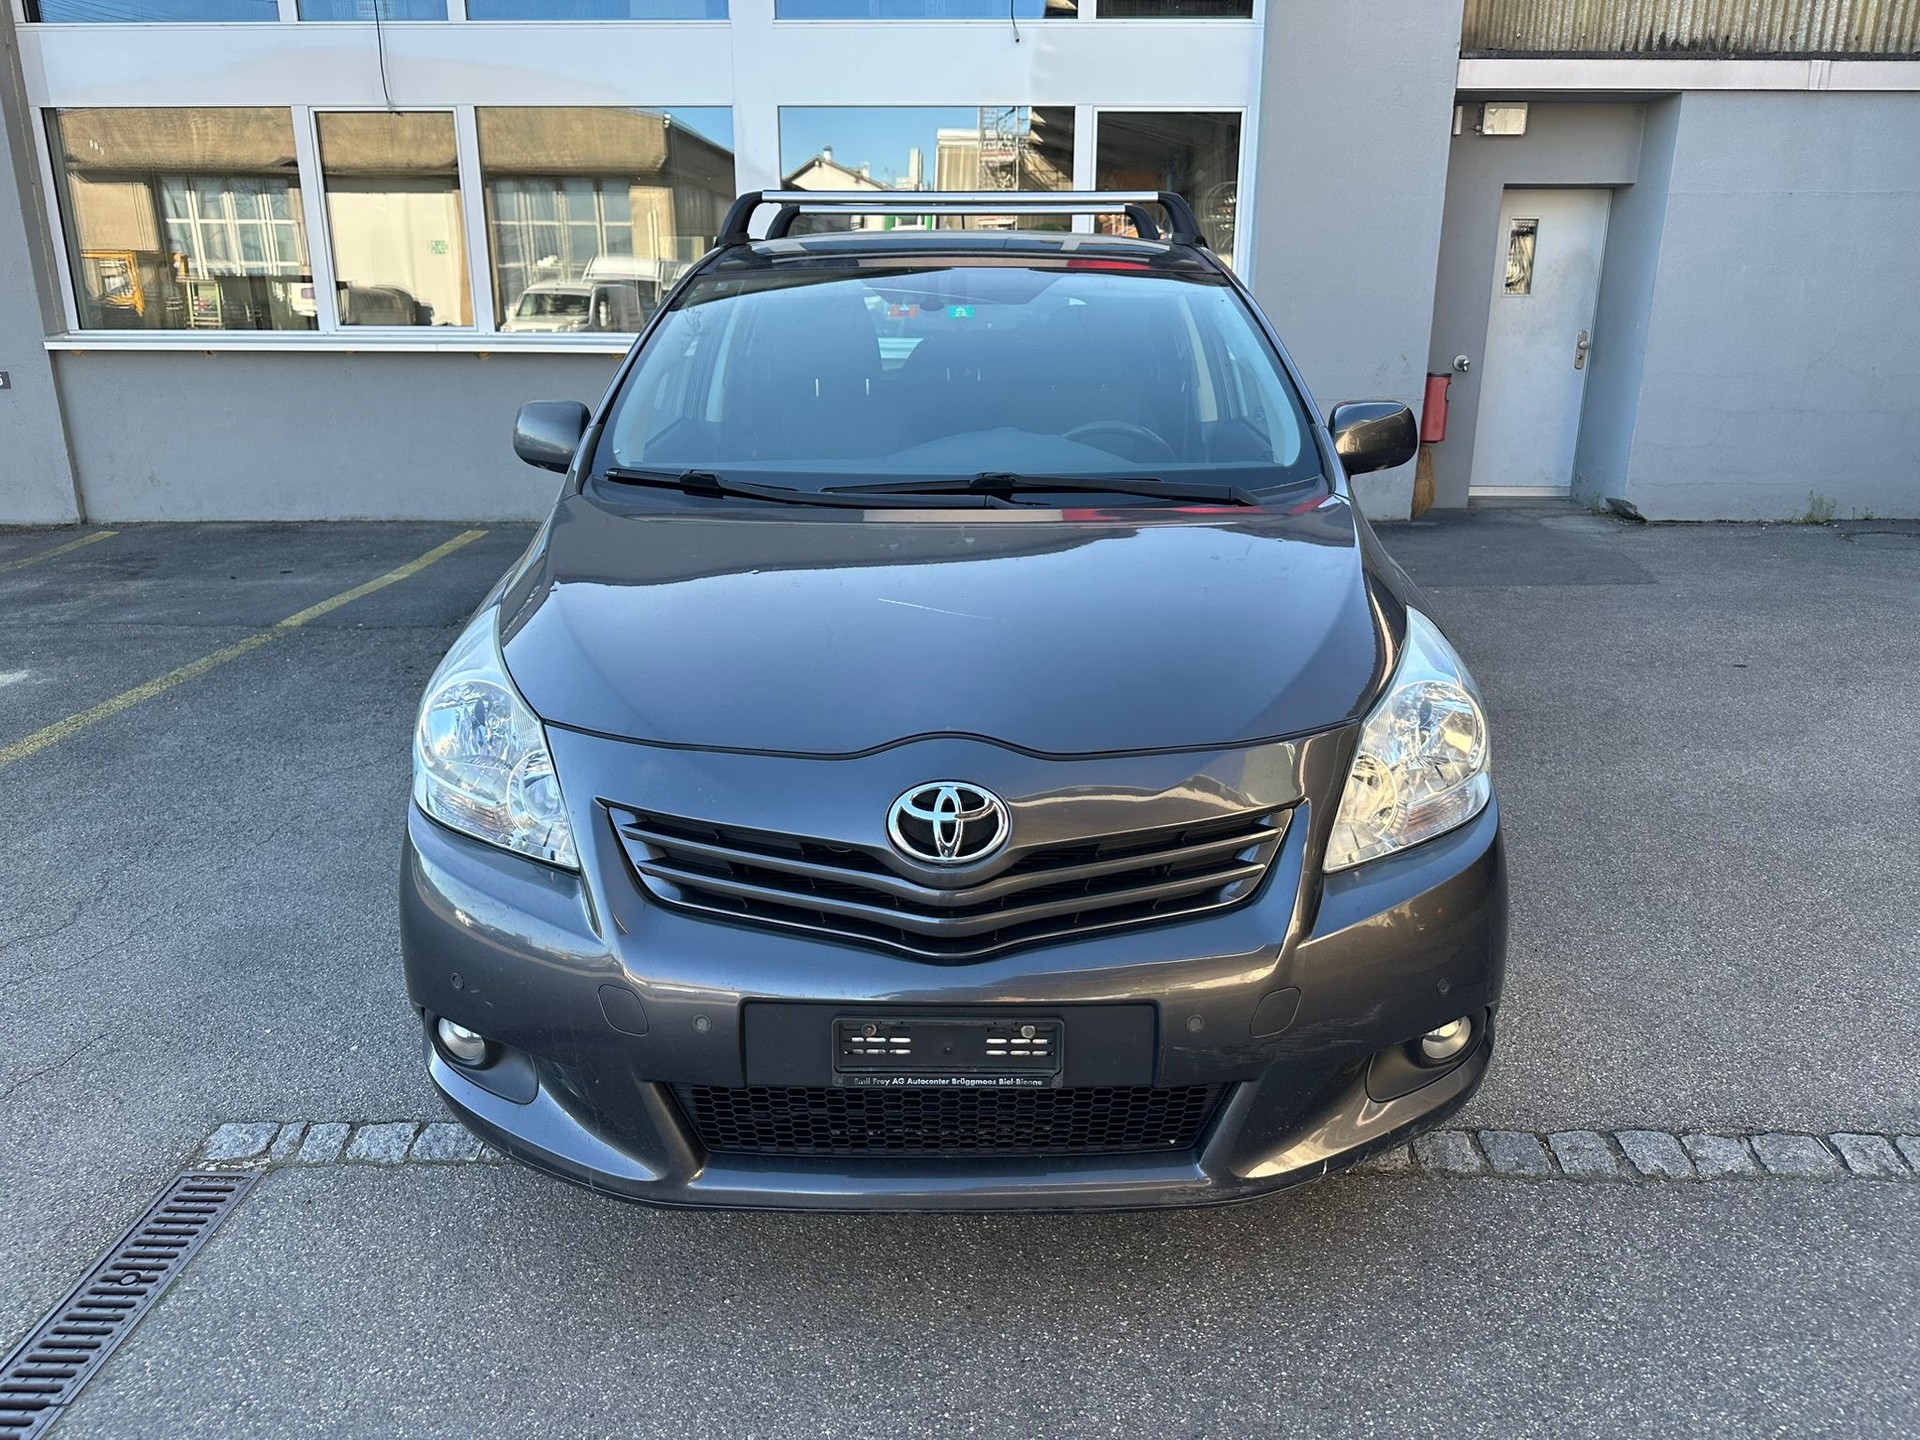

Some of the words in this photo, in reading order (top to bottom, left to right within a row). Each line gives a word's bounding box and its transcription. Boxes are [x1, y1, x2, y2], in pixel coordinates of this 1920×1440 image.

[872, 1077, 890, 1086] Frey
[892, 1077, 905, 1085] AG
[906, 1077, 950, 1085] Autocenter
[951, 1077, 997, 1086] Brüggmoos
[998, 1077, 1043, 1086] Biel-Bienne
